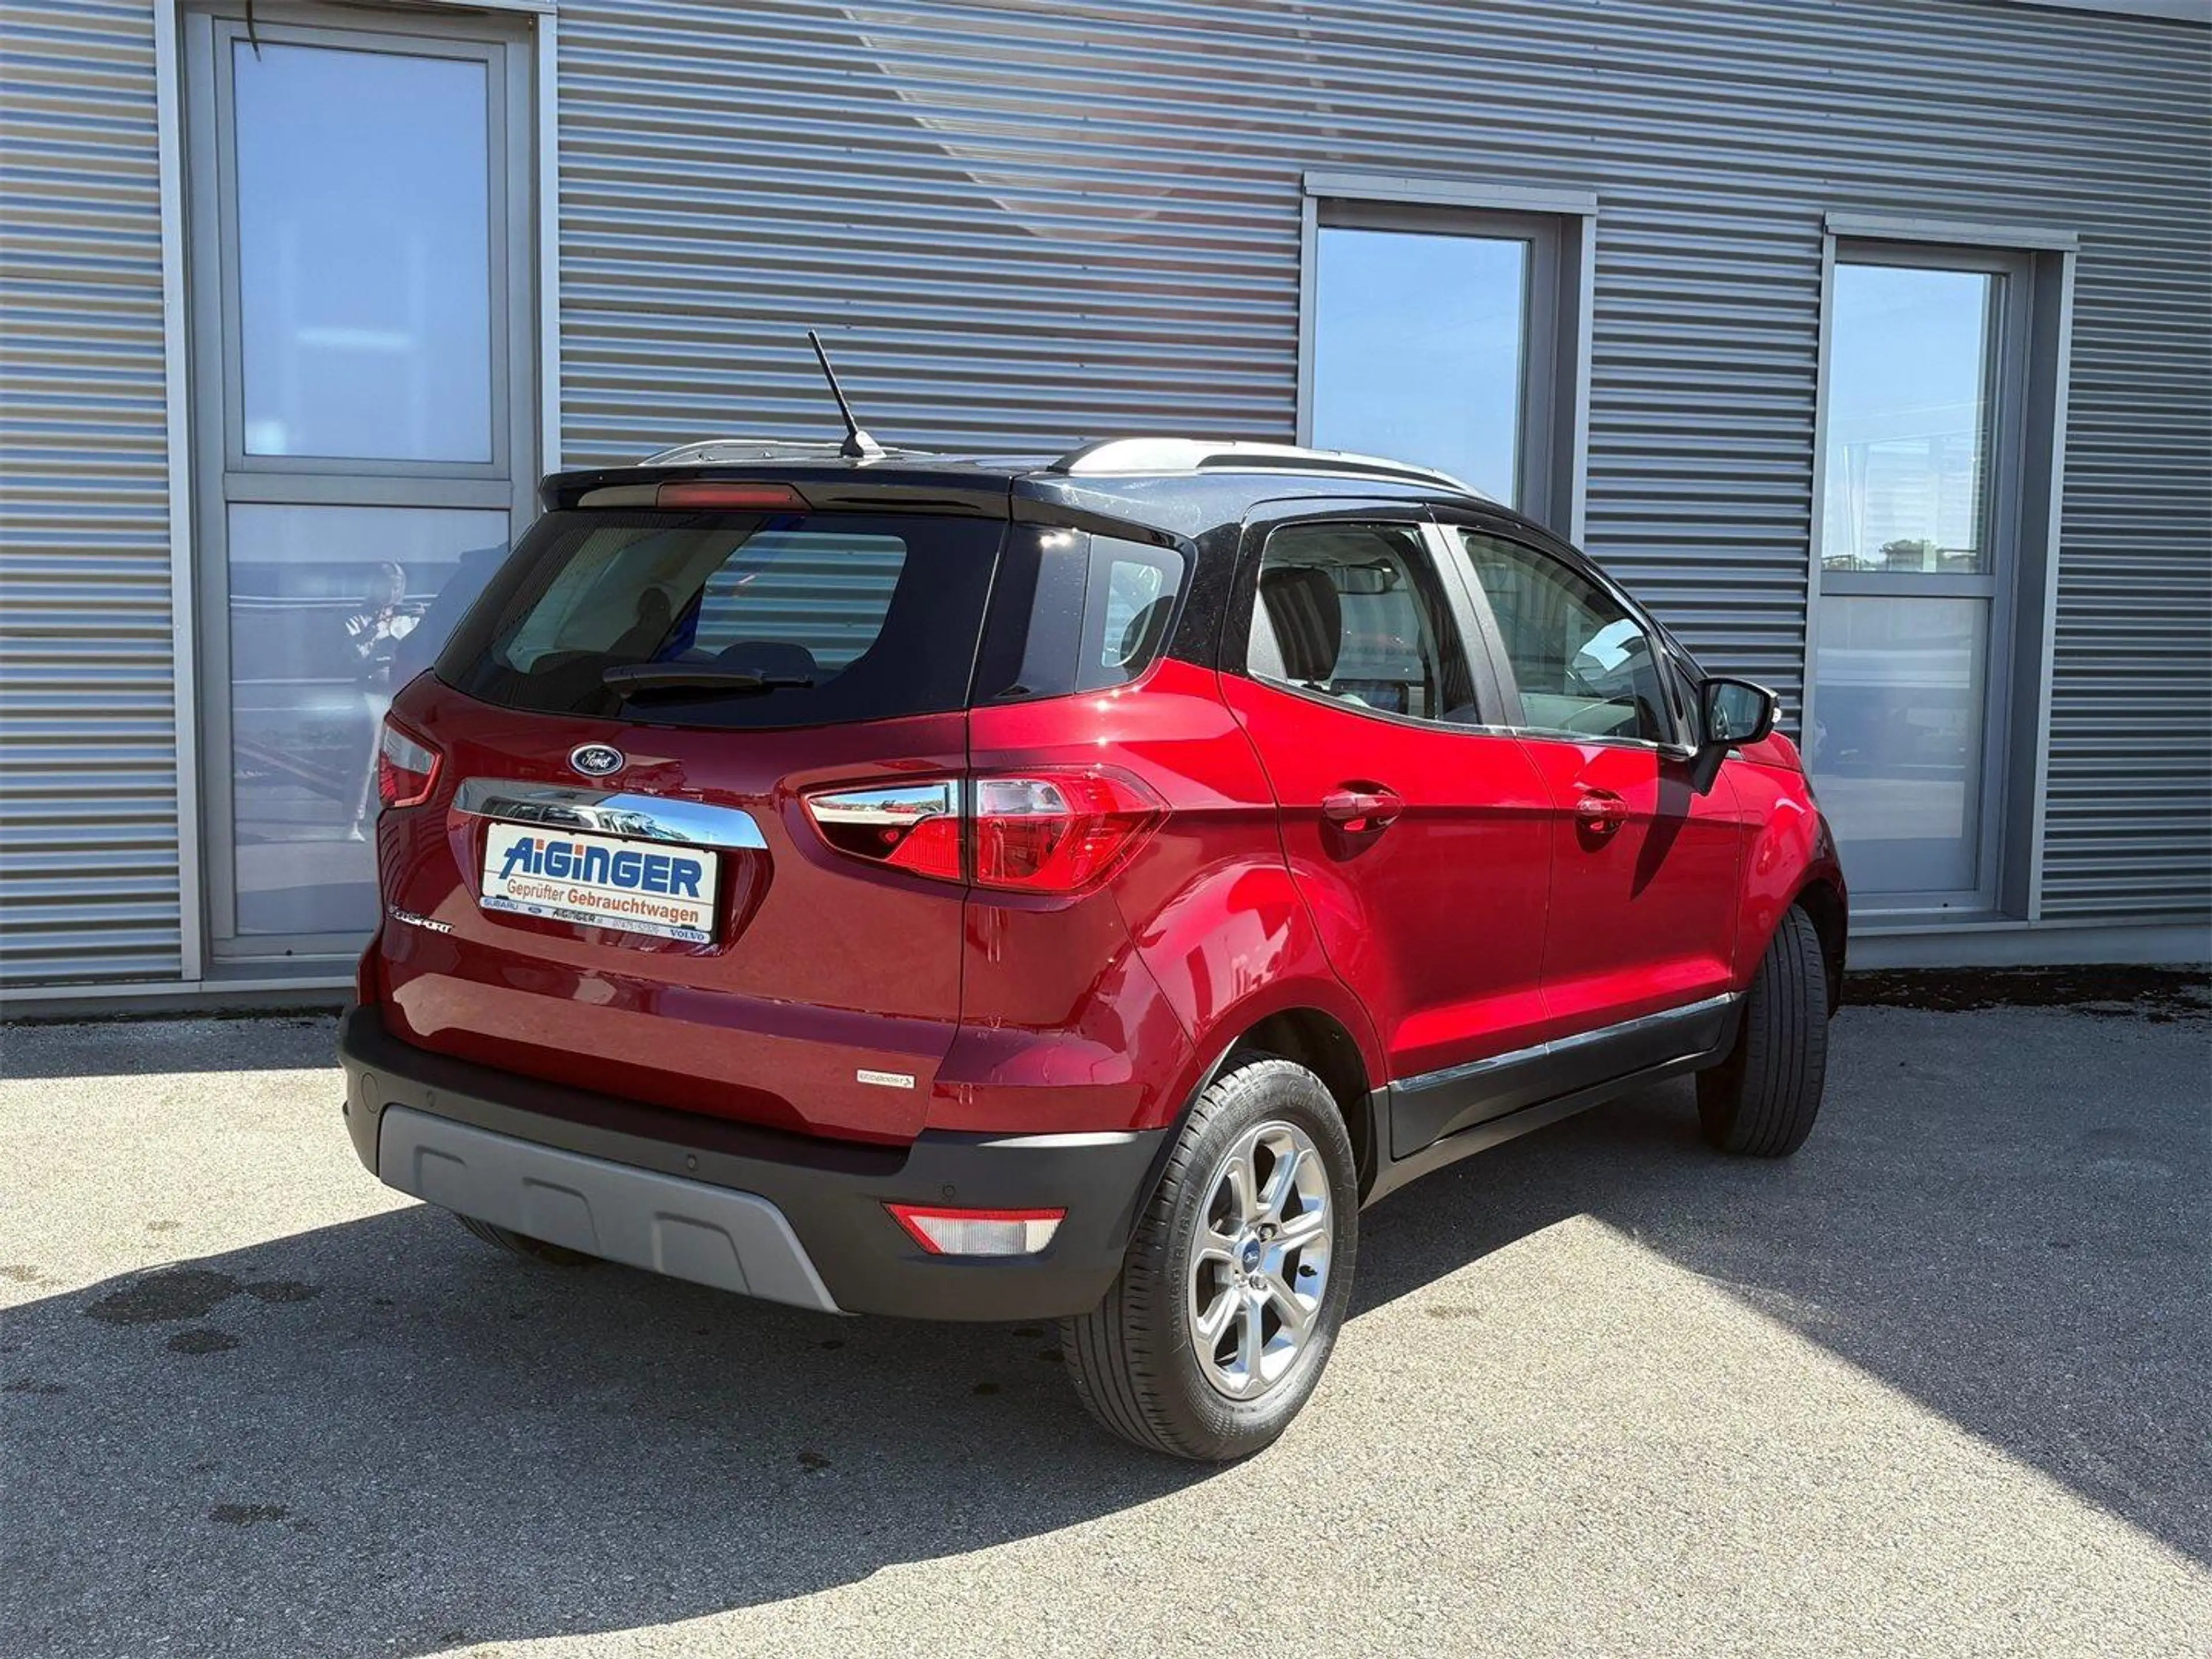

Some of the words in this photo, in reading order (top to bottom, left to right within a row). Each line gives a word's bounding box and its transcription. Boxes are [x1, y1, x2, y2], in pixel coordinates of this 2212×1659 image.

[581, 749, 611, 768] Ford
[484, 899, 518, 910] SUBARU
[670, 928, 704, 941] VOLVO
[507, 878, 565, 903] Geprüfter
[567, 888, 699, 923] Gebrauchtwagen
